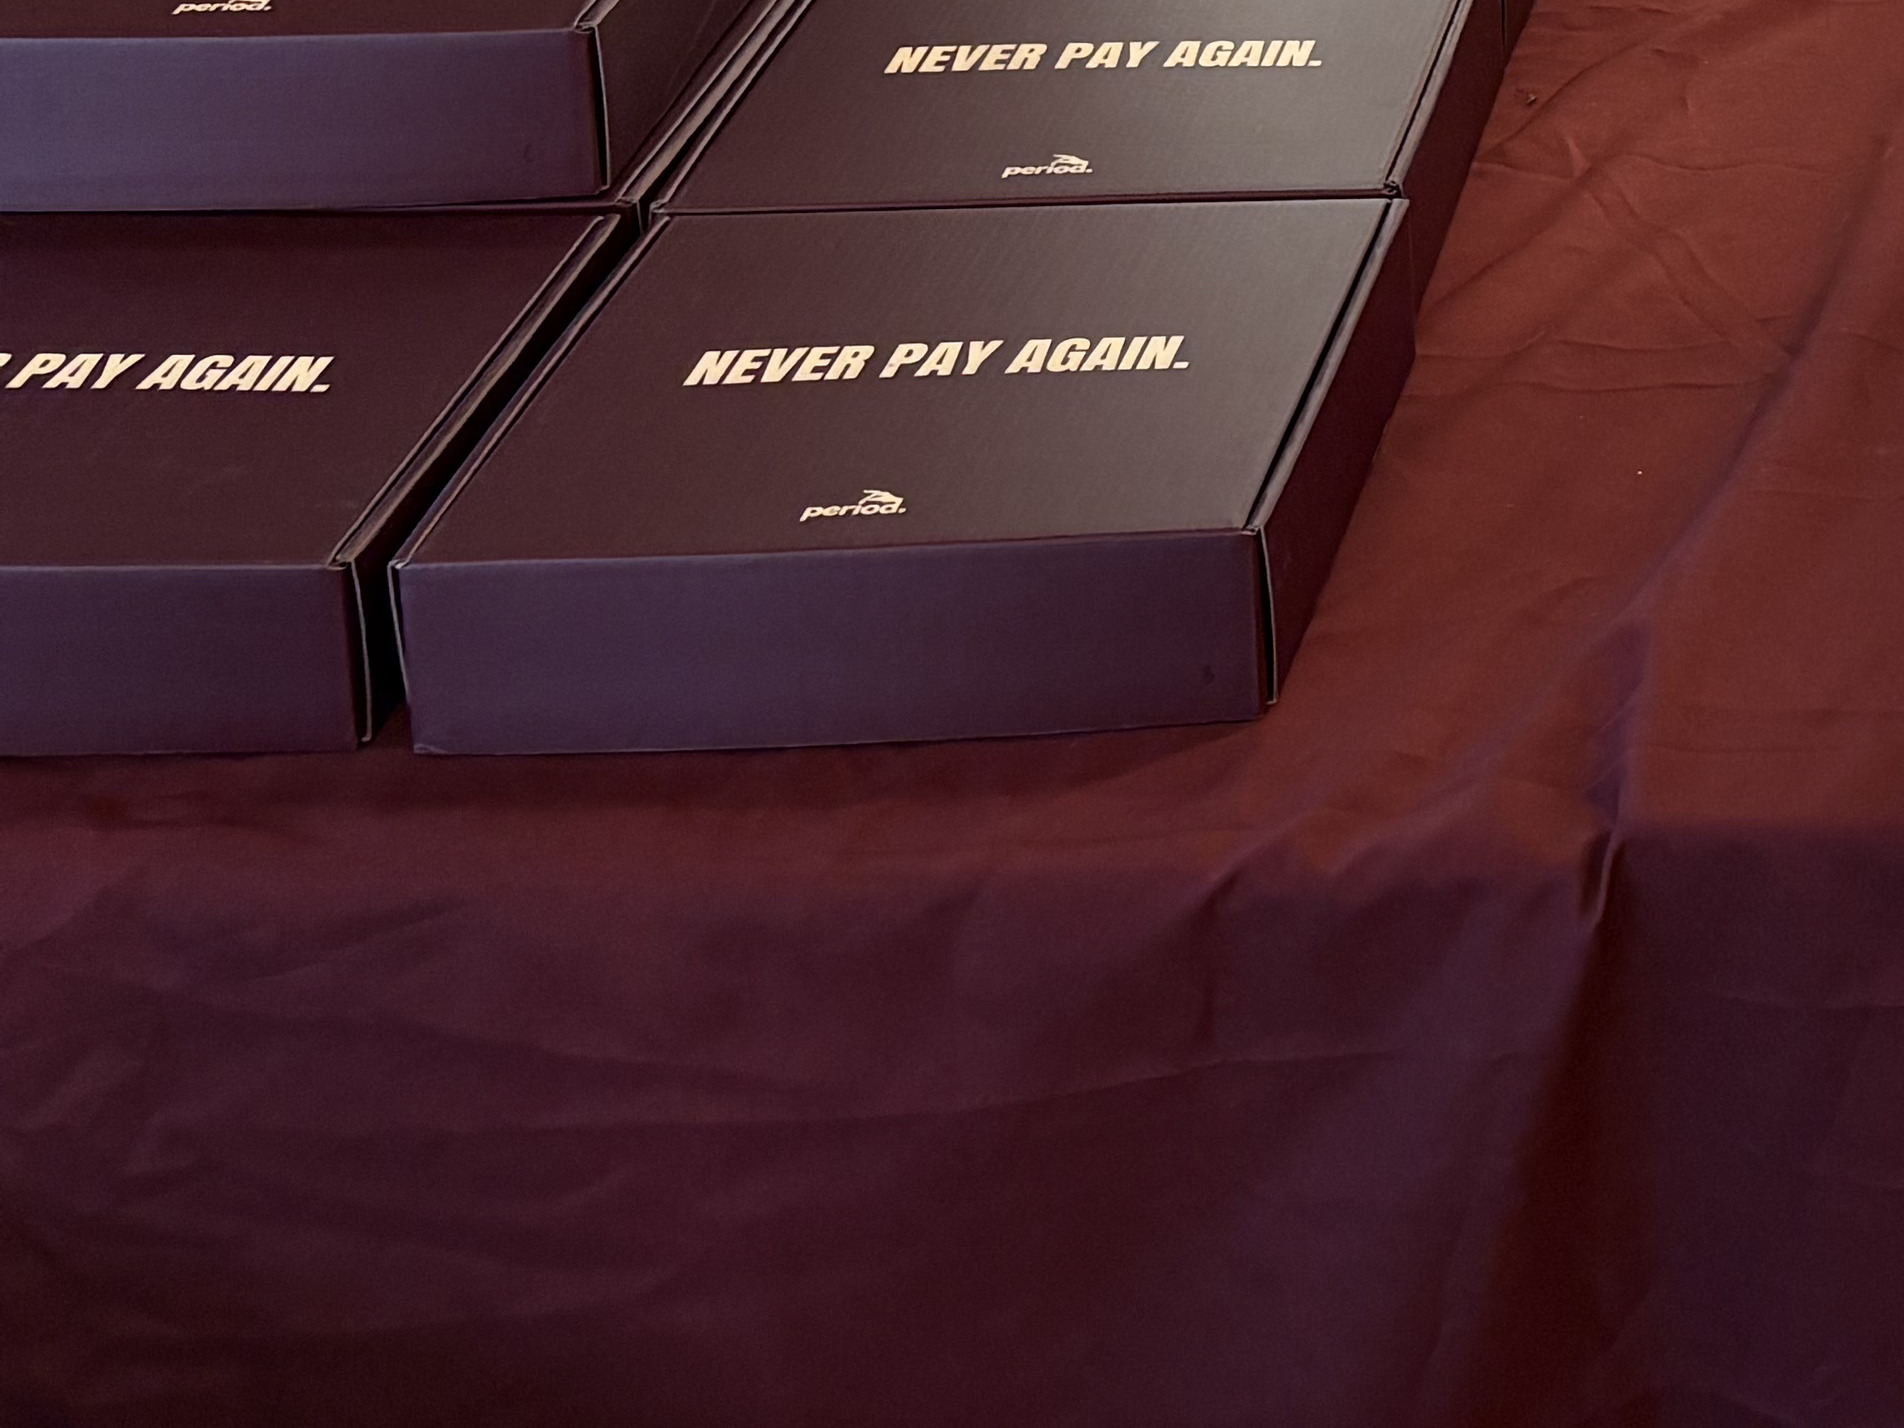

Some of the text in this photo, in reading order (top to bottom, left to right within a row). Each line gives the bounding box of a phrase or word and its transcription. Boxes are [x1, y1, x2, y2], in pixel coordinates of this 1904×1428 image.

[884, 39, 1322, 74] NEVER PAY AGAIN.
[1001, 161, 1093, 179] period.
[5, 352, 335, 393] PAY AGAIN.
[682, 335, 1190, 386] NEVER PAY AGAIN.
[799, 498, 907, 522] period.
